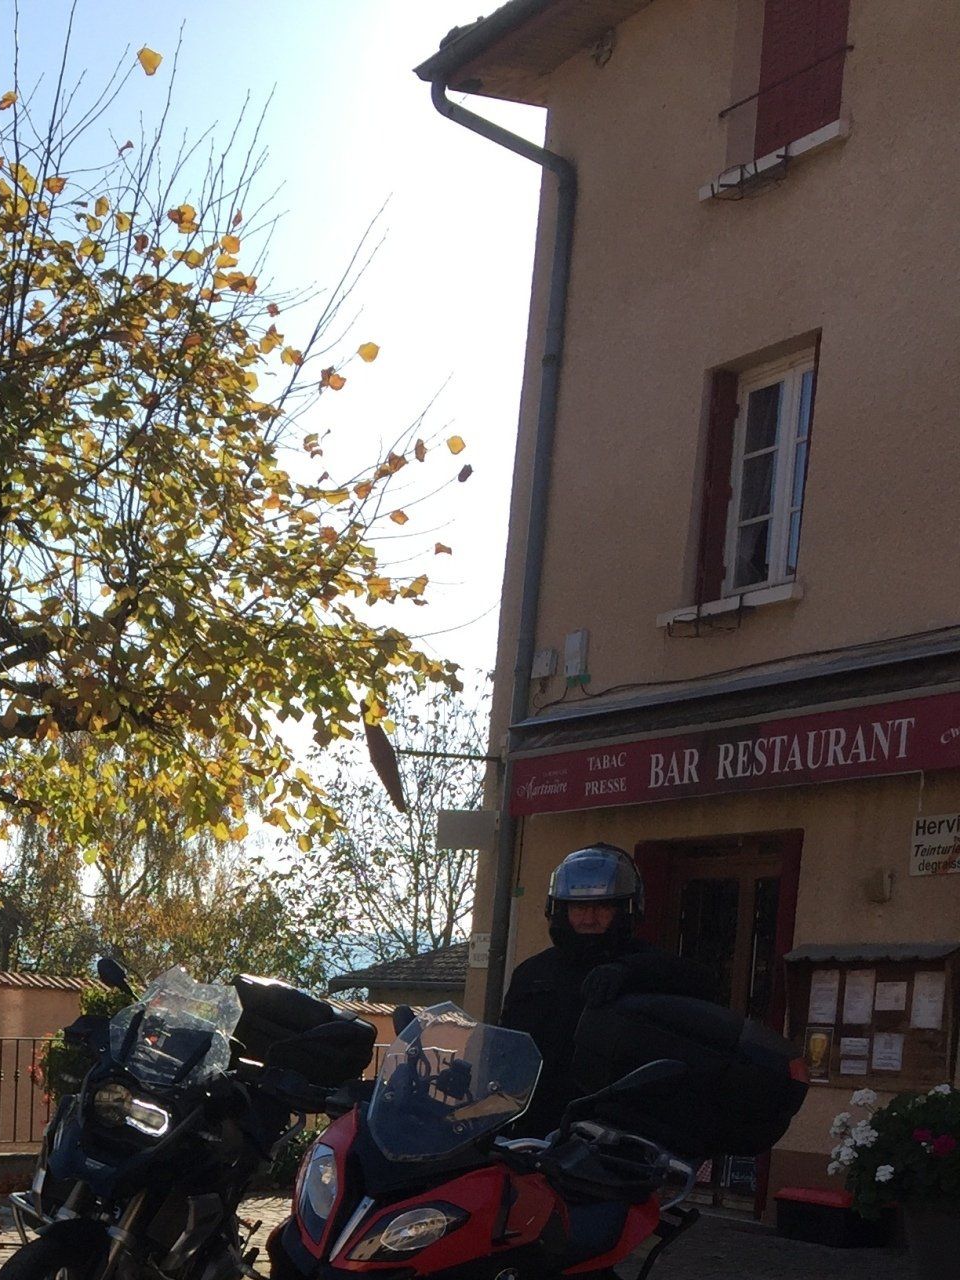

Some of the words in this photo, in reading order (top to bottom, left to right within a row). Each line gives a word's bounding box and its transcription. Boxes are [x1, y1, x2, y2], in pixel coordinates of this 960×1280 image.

[587, 752, 627, 771] TABAC
[648, 749, 700, 788] BAR
[715, 717, 916, 780] RESTAURANT
[584, 777, 627, 796] PRESSE
